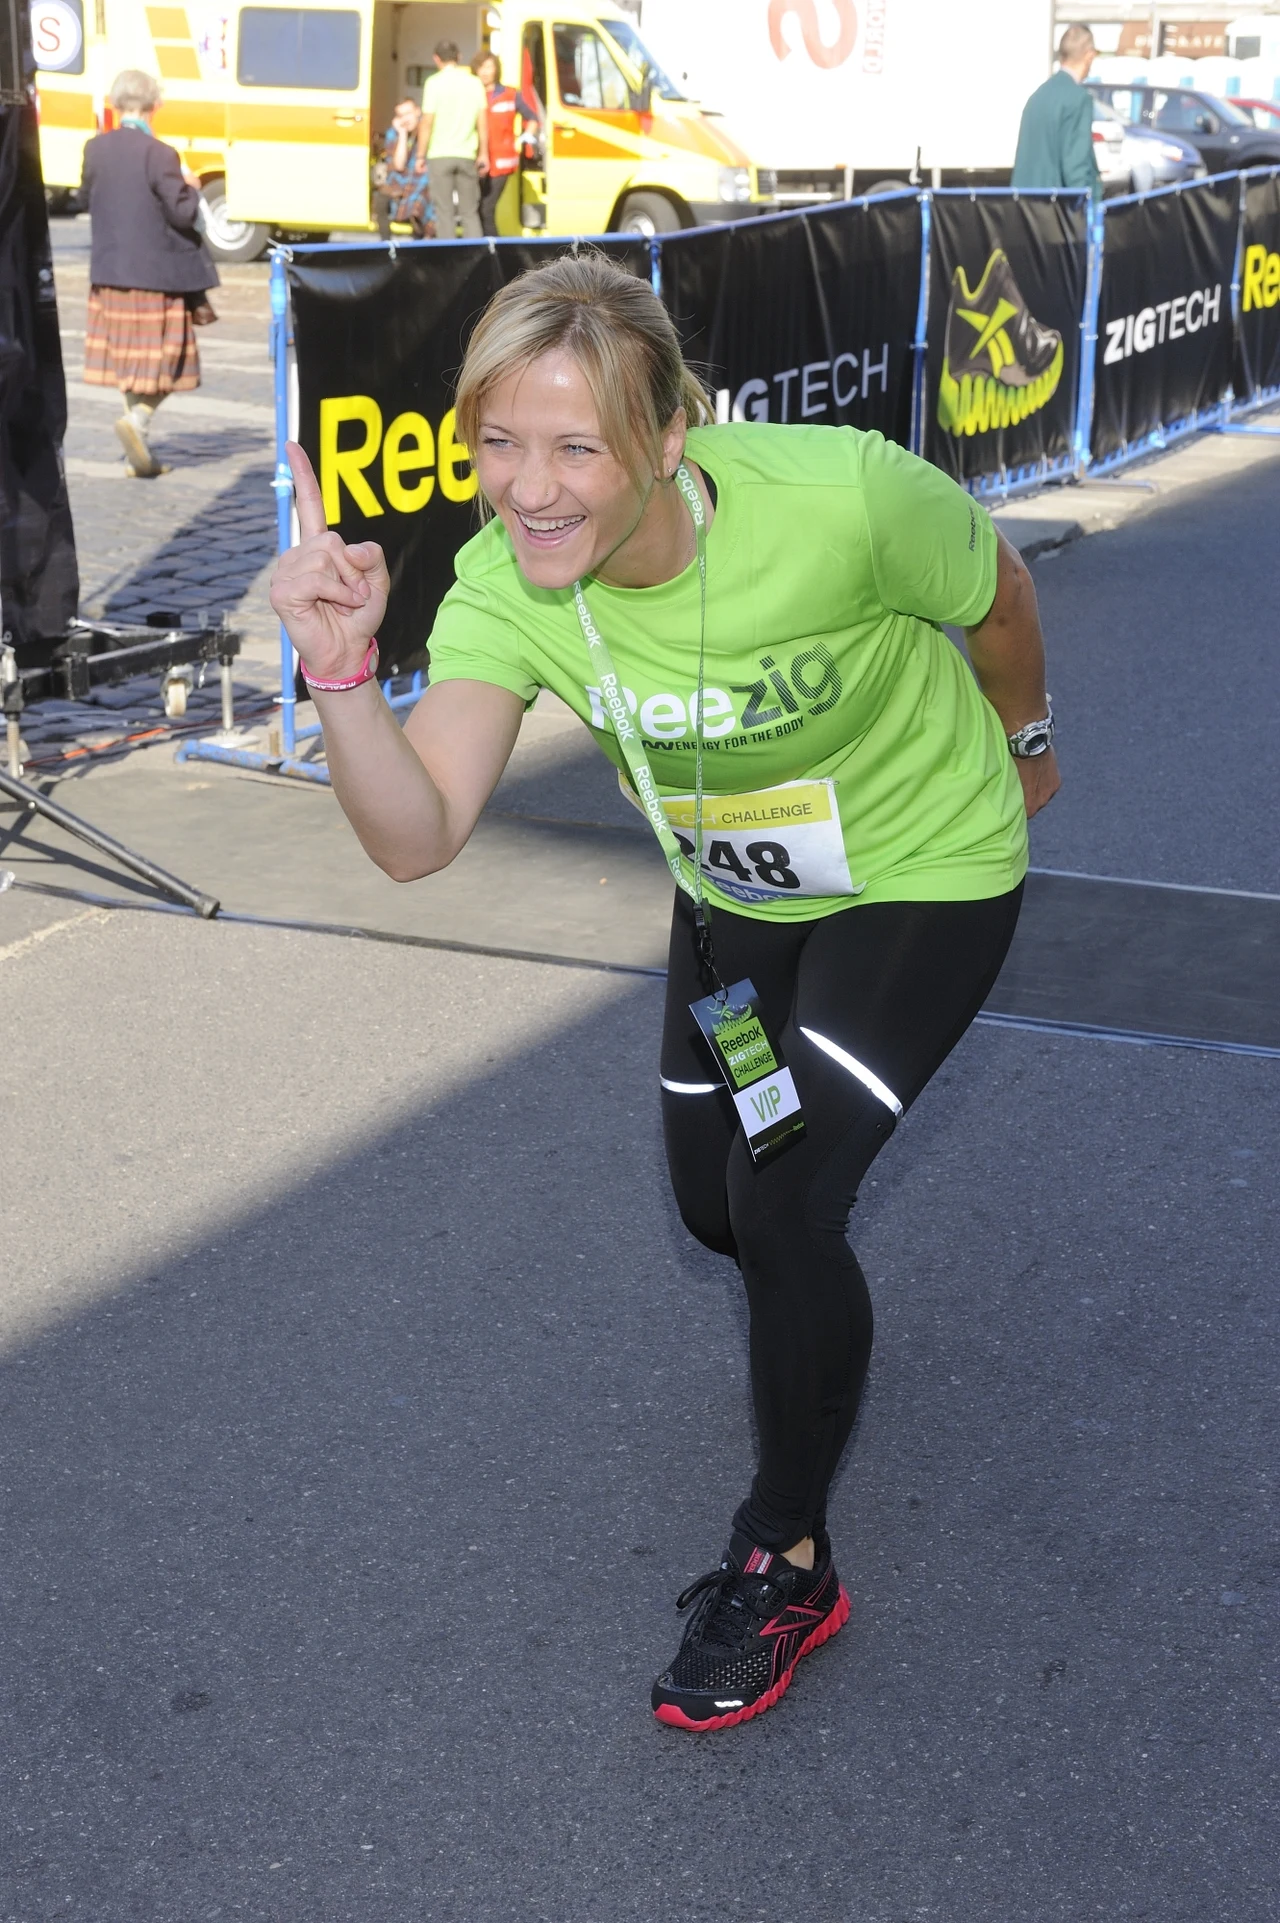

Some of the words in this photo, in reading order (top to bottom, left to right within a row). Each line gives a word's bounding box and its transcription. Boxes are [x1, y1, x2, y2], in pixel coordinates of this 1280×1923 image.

[1103, 283, 1222, 366] ZIGTECH
[698, 342, 888, 424] IGTECH
[319, 395, 479, 525] Ree
[677, 464, 704, 526] Reebo
[600, 672, 635, 743] Reebok
[724, 735, 748, 750] FOR
[750, 729, 773, 743] THE
[775, 716, 805, 737] BODY
[634, 765, 668, 834] Reebok
[721, 802, 813, 824] CHALLENGE
[670, 857, 698, 898] Reeb
[721, 1025, 764, 1055] Reebok
[728, 1040, 769, 1067] ZIGTECH
[733, 1051, 774, 1079] CHALLENGE
[749, 1085, 781, 1123] VIP
